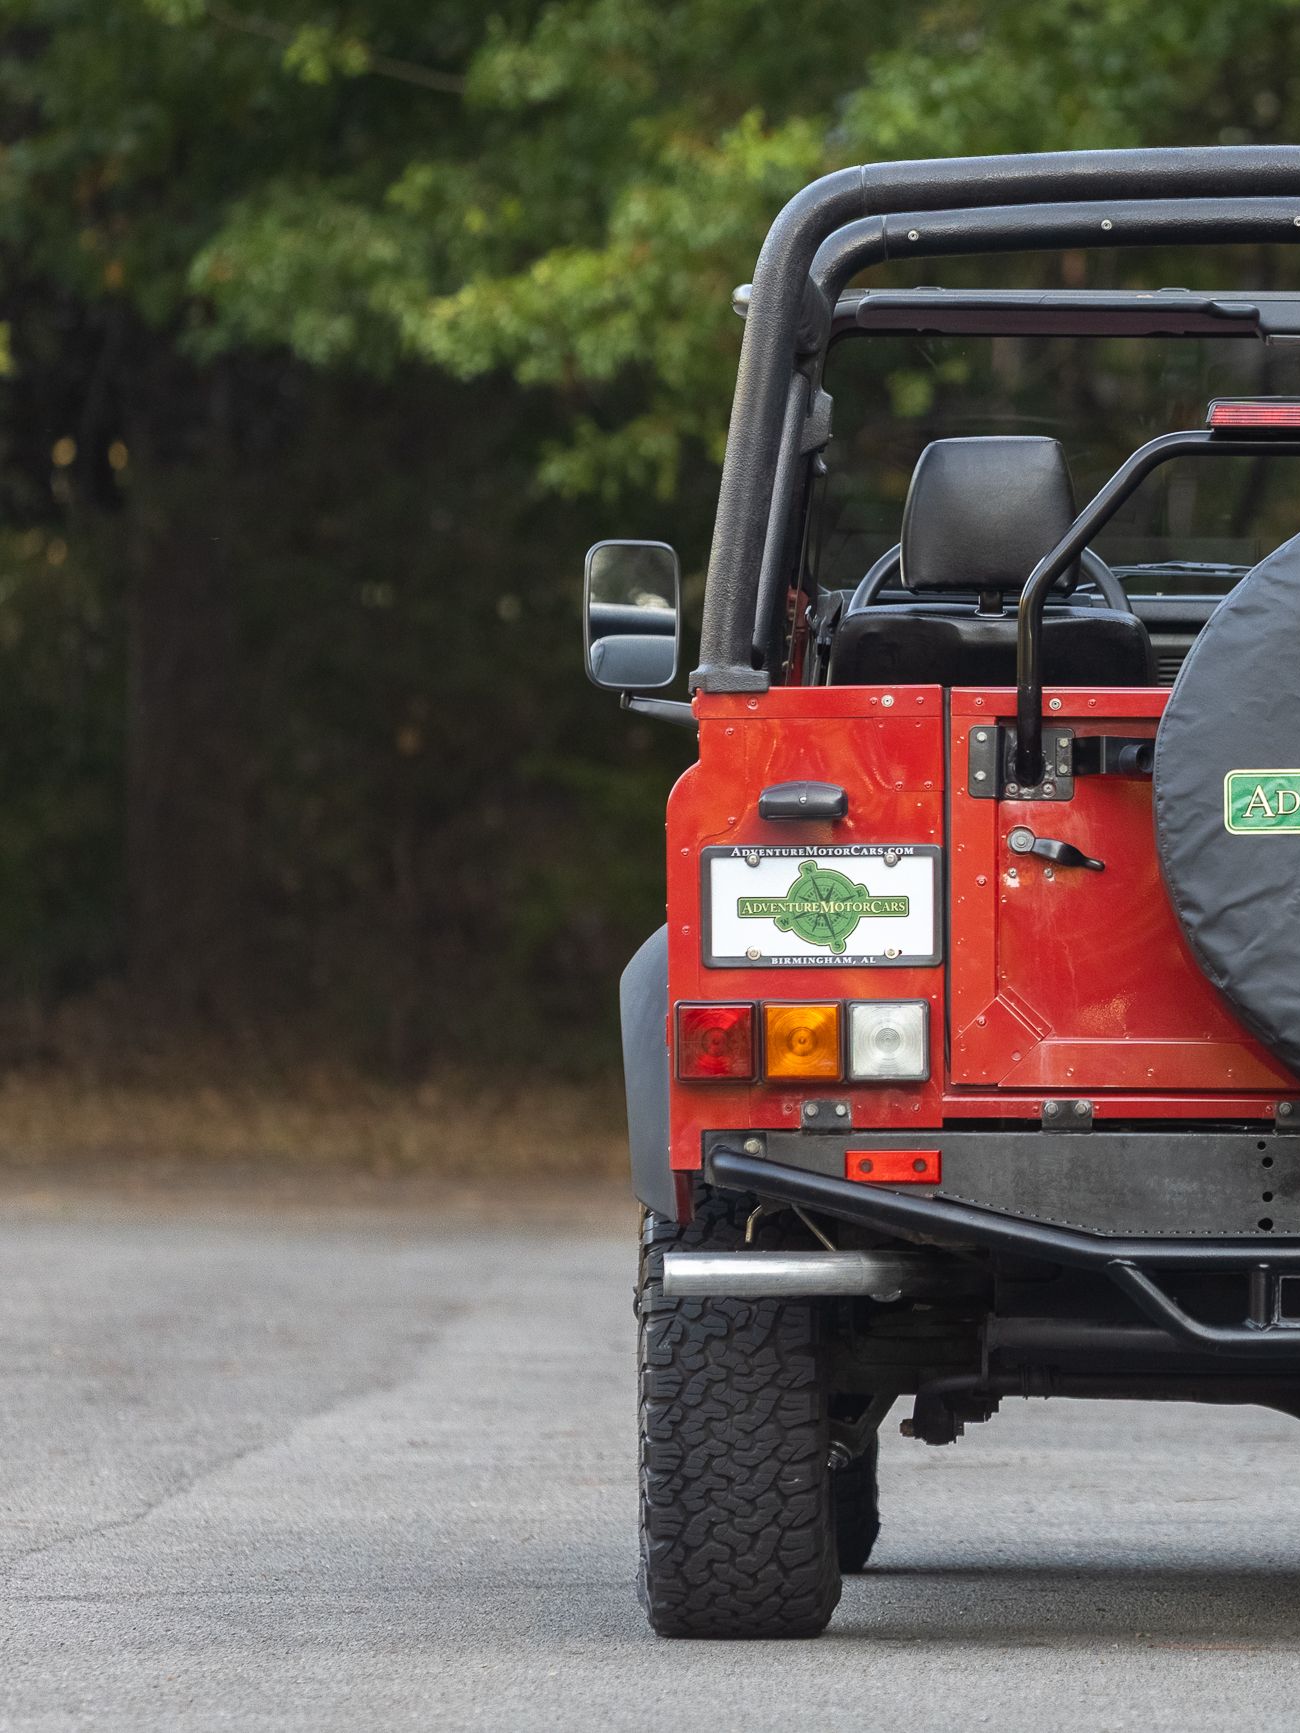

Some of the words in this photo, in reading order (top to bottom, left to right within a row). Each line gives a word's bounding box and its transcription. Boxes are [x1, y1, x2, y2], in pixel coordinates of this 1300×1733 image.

[742, 901, 905, 914] ADVENTUREMOTORCARS
[771, 956, 857, 965] BIRMINGHAM,
[860, 956, 877, 964] AL
